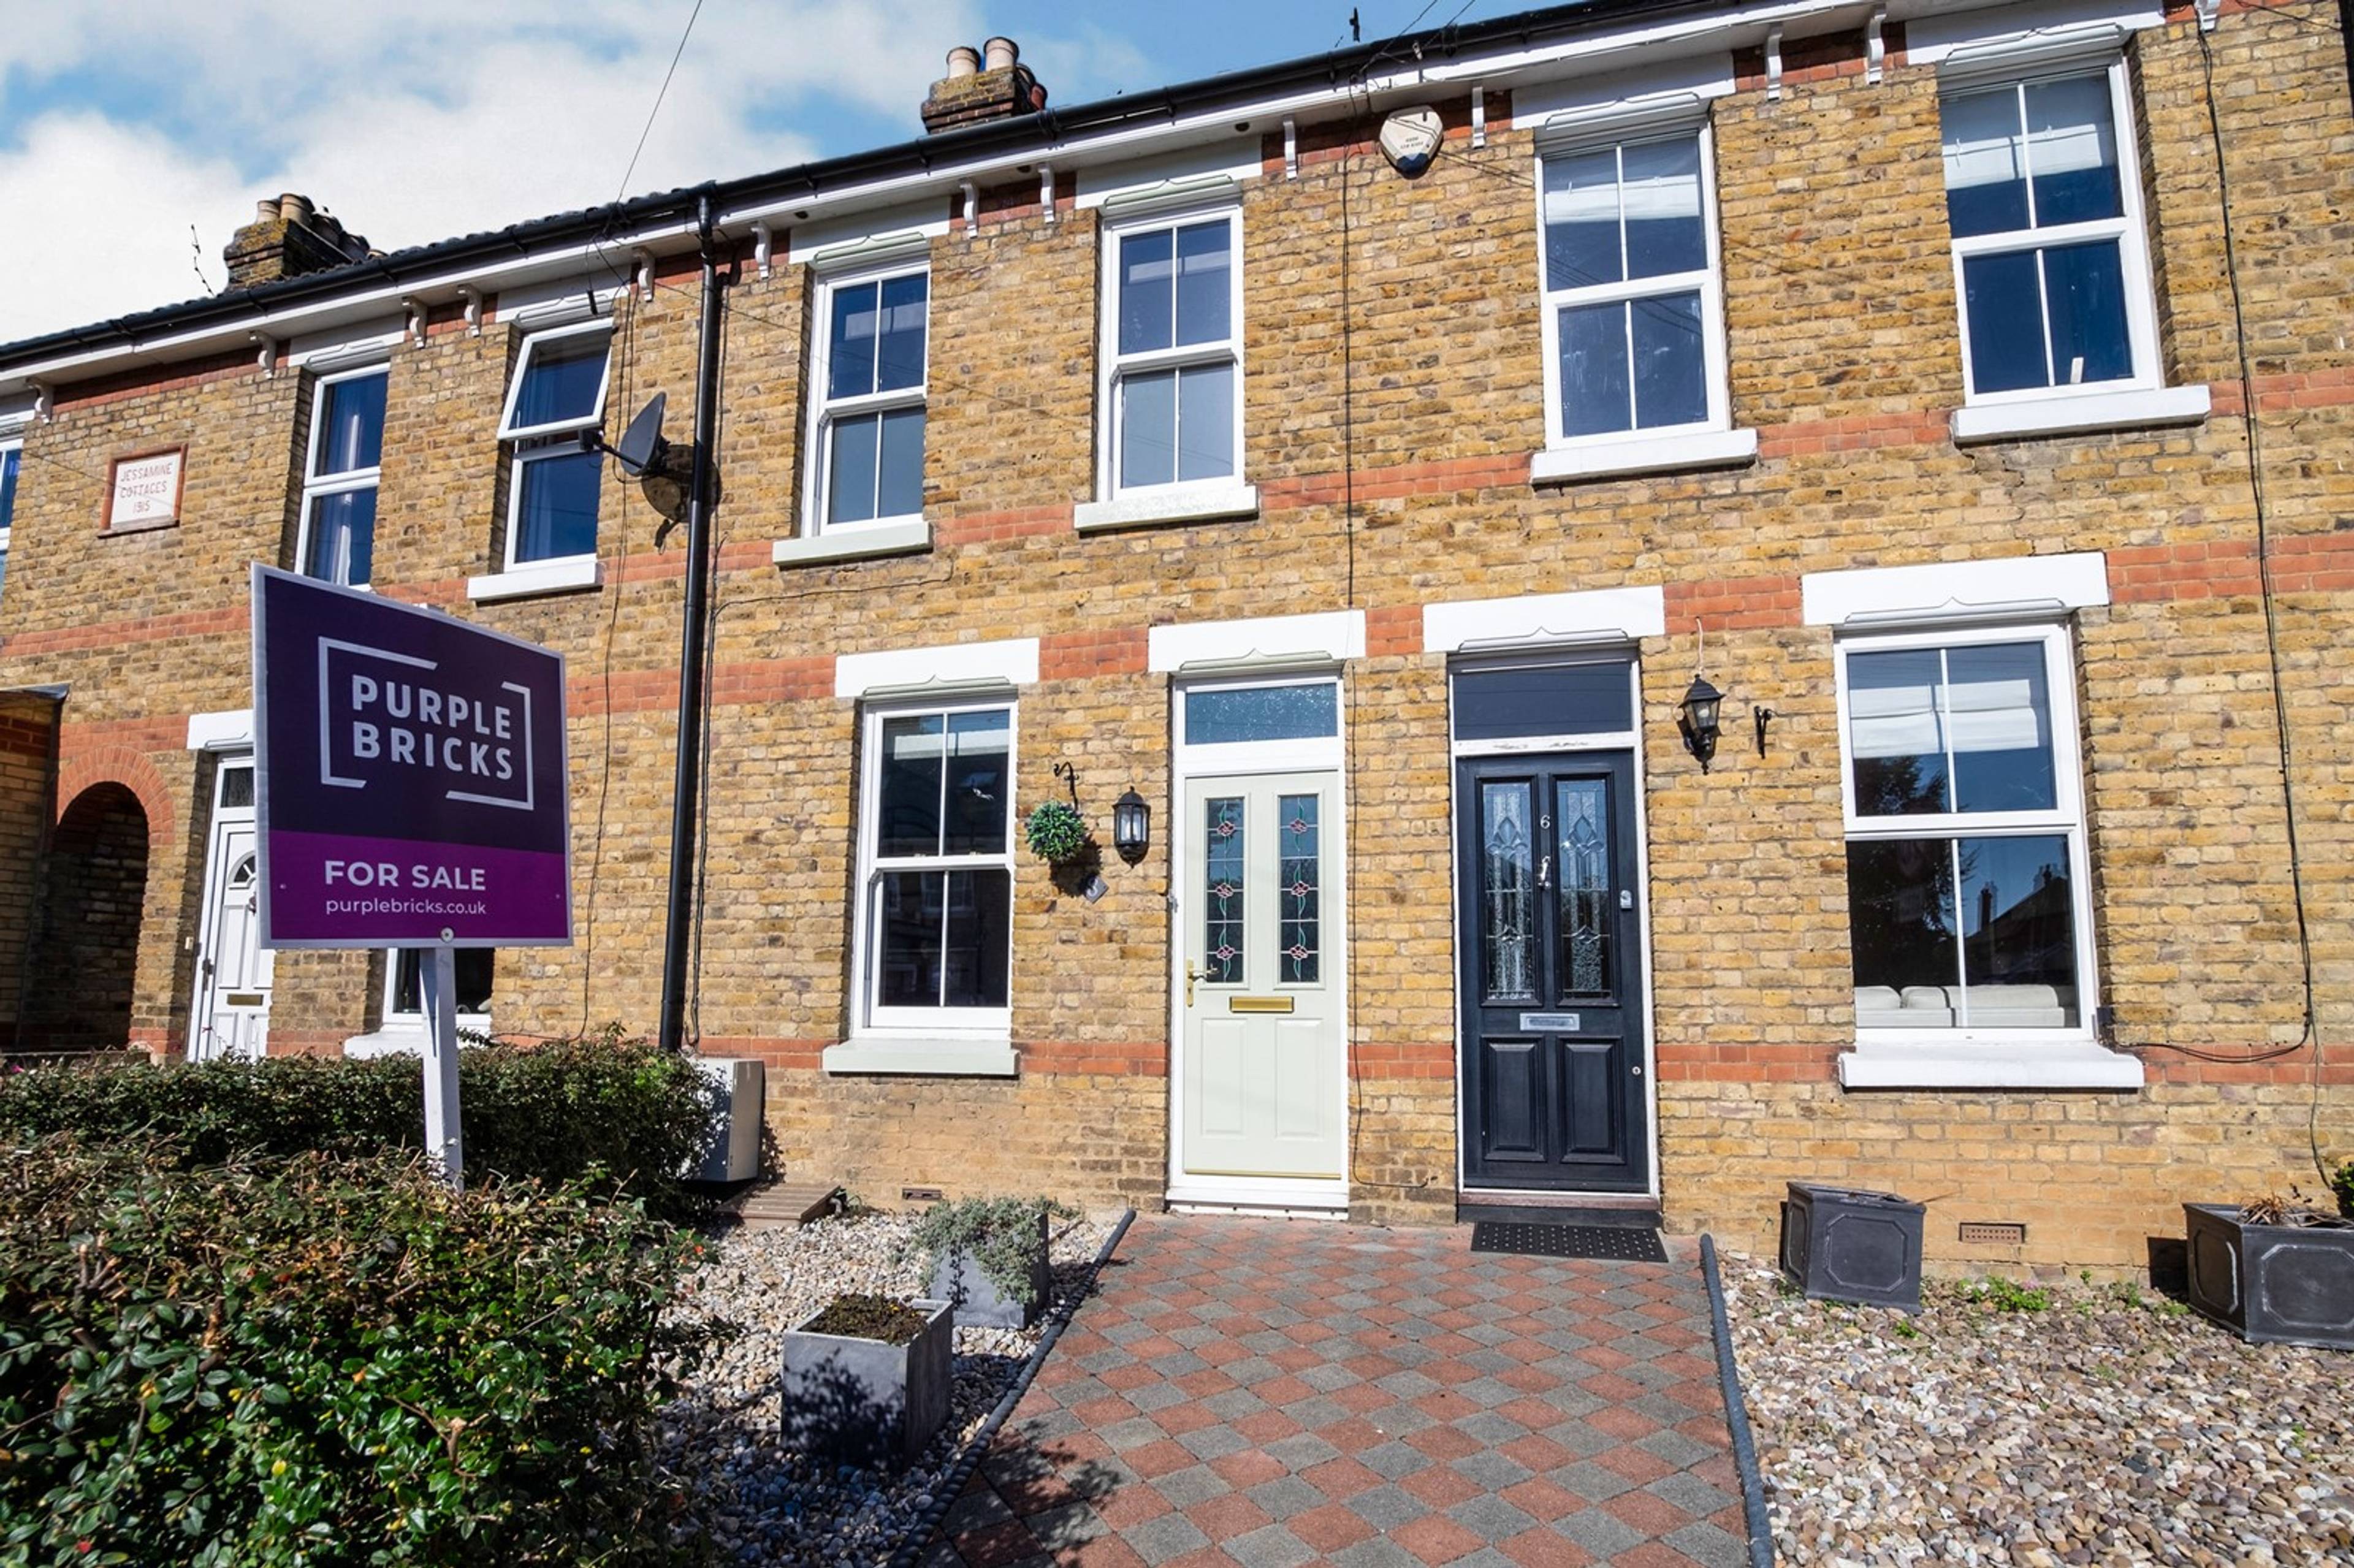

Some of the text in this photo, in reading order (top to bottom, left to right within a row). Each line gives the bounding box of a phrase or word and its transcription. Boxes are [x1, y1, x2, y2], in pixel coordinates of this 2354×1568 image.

[352, 674, 511, 739] PURPLE
[353, 721, 512, 780] BRICKS
[1540, 815, 1550, 829] 6
[325, 860, 486, 891] FOR SALE
[326, 897, 486, 915] purplebricks.co.uk
